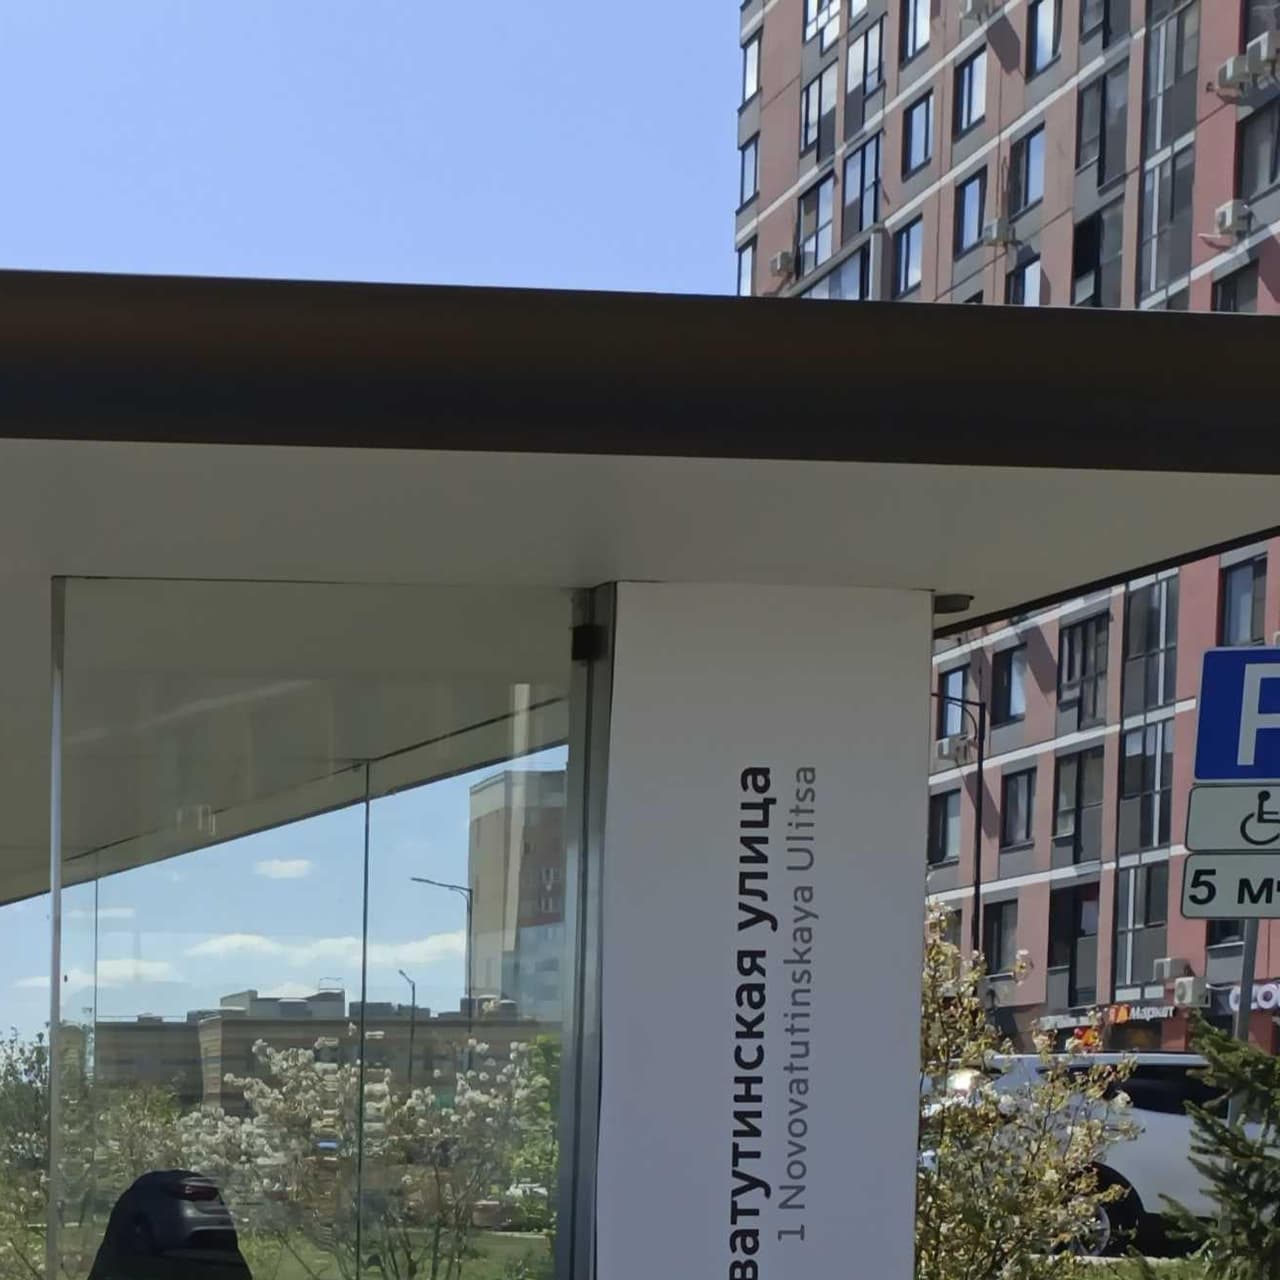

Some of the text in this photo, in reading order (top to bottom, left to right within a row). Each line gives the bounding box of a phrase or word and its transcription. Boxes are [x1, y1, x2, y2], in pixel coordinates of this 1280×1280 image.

[737, 767, 778, 933] улица
[1189, 868, 1217, 905] 5
[777, 767, 819, 1241] 1 Novovatutinskaya Ulitsa
